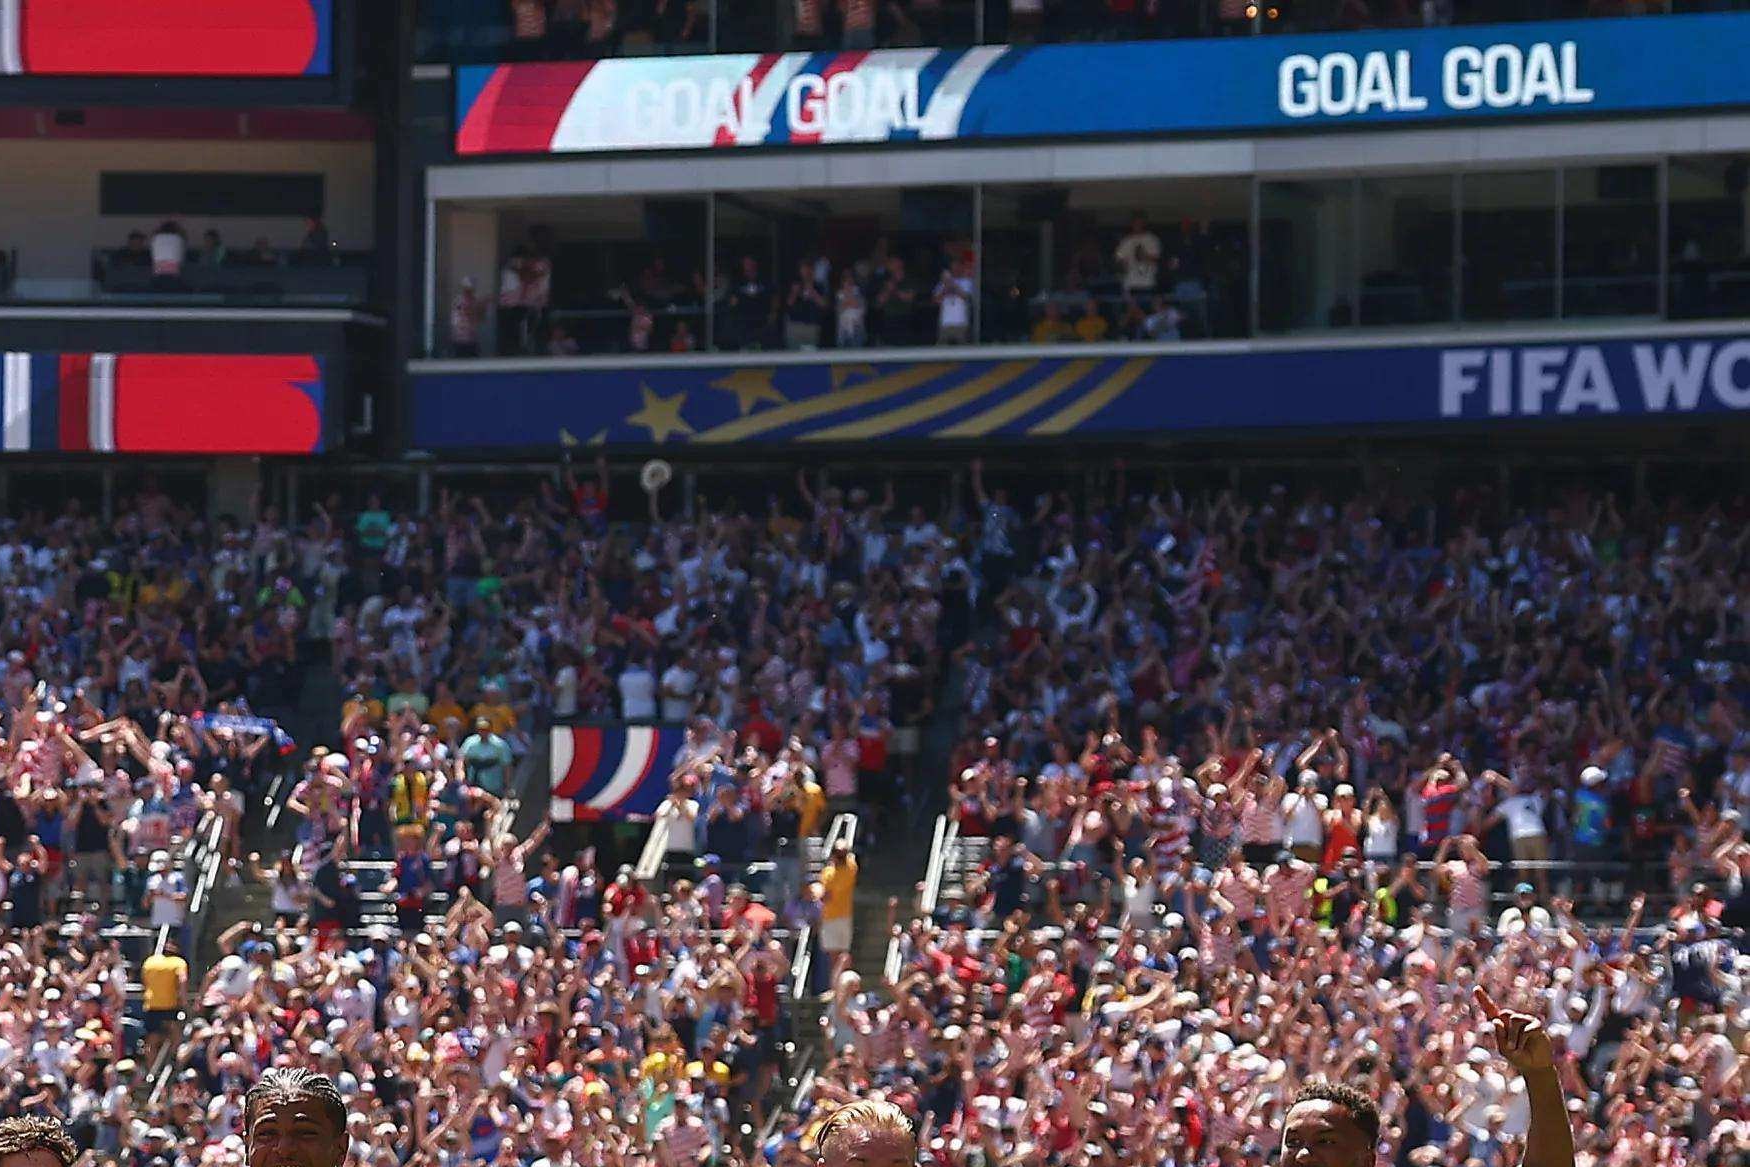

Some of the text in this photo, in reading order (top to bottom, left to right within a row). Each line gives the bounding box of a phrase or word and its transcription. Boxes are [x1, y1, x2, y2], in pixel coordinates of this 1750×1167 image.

[787, 65, 928, 134] GOAL
[1278, 41, 1594, 118] GOAL GOAL
[1439, 339, 1750, 418] FIFA WO
